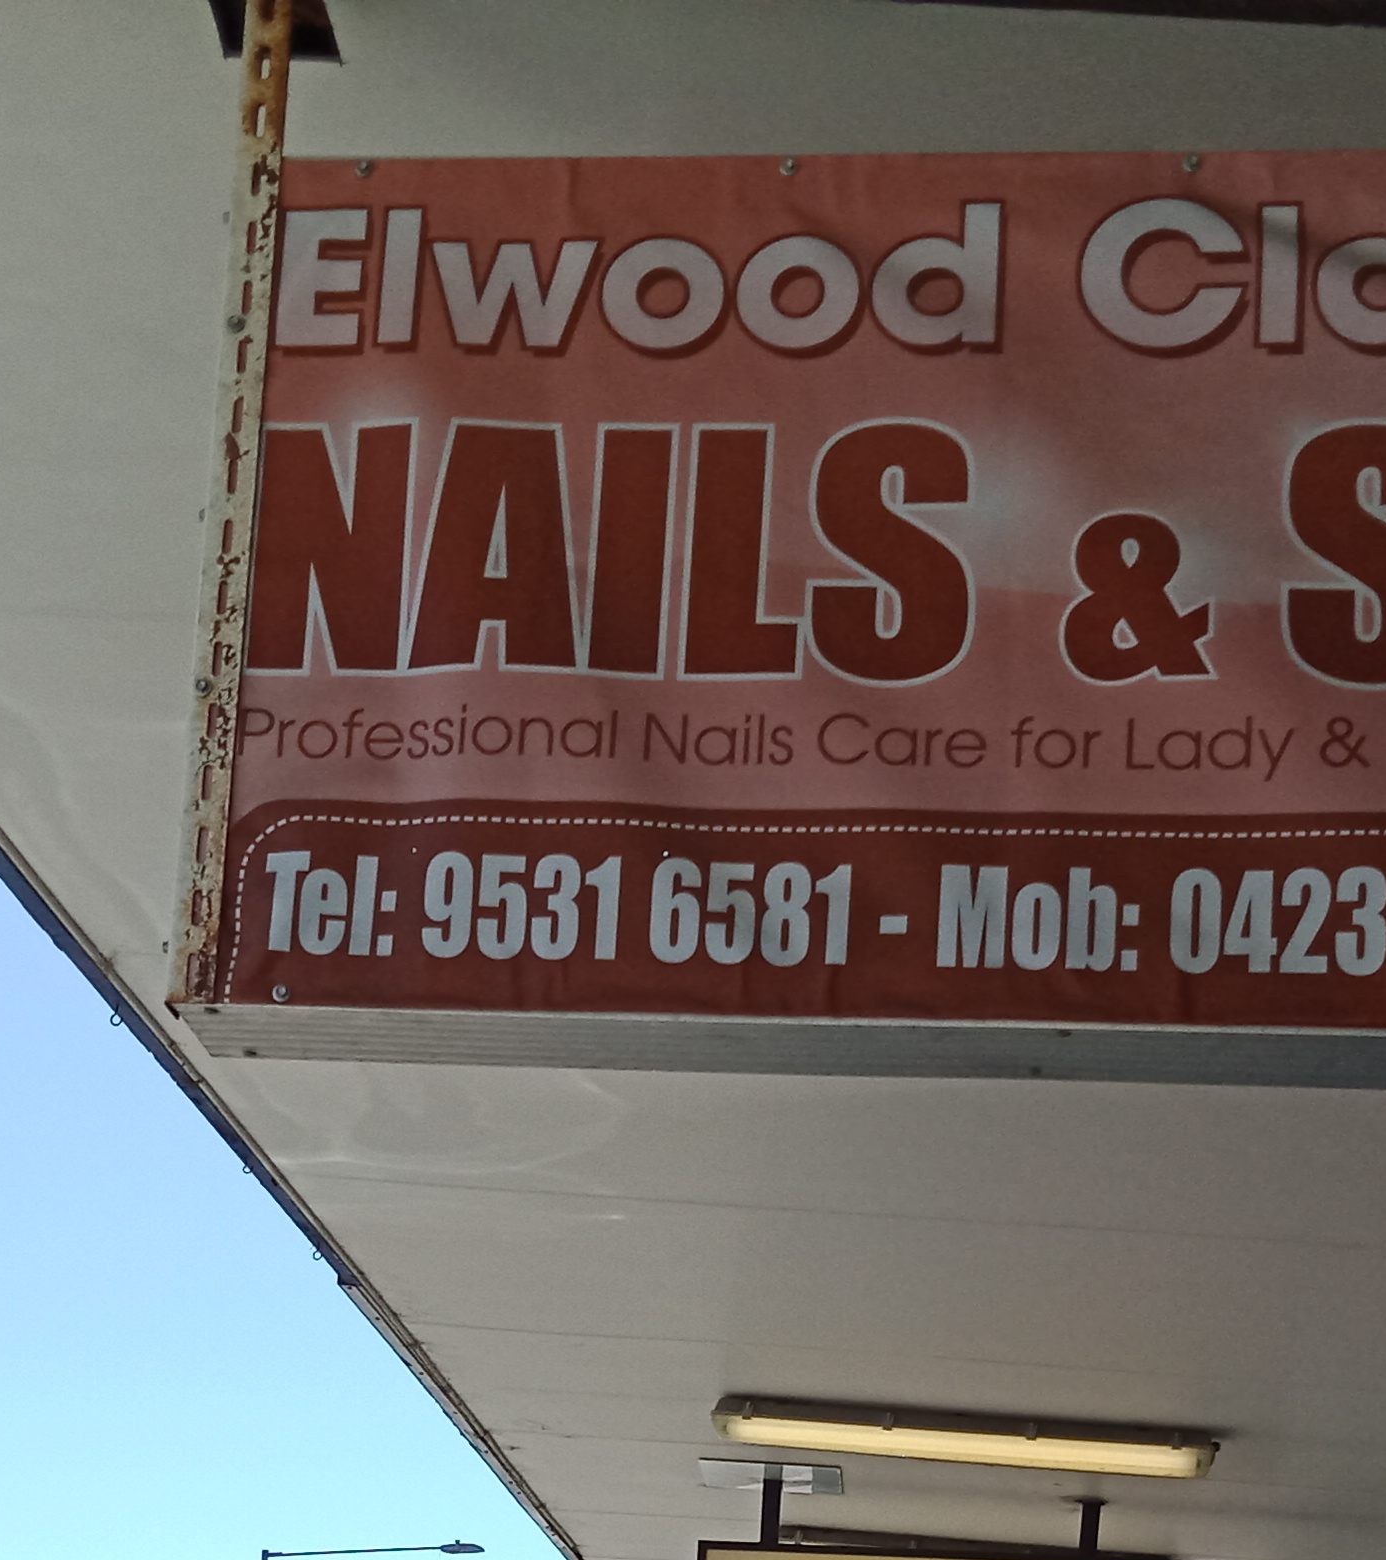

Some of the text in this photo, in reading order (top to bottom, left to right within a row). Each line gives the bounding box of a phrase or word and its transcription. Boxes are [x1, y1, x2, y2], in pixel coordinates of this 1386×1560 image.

[273, 199, 1007, 356] Elwood
[247, 416, 978, 681] NAILS
[1058, 509, 1217, 685] &
[236, 700, 621, 762] Professional
[643, 710, 796, 768] Nails
[820, 710, 989, 771] Care
[1009, 711, 1103, 771] for
[1125, 716, 1296, 783] Lady
[1319, 719, 1373, 774] &
[265, 848, 395, 958] Tel:
[421, 850, 622, 963] 9531
[647, 855, 852, 967] 6581
[937, 864, 1141, 972] Mob:
